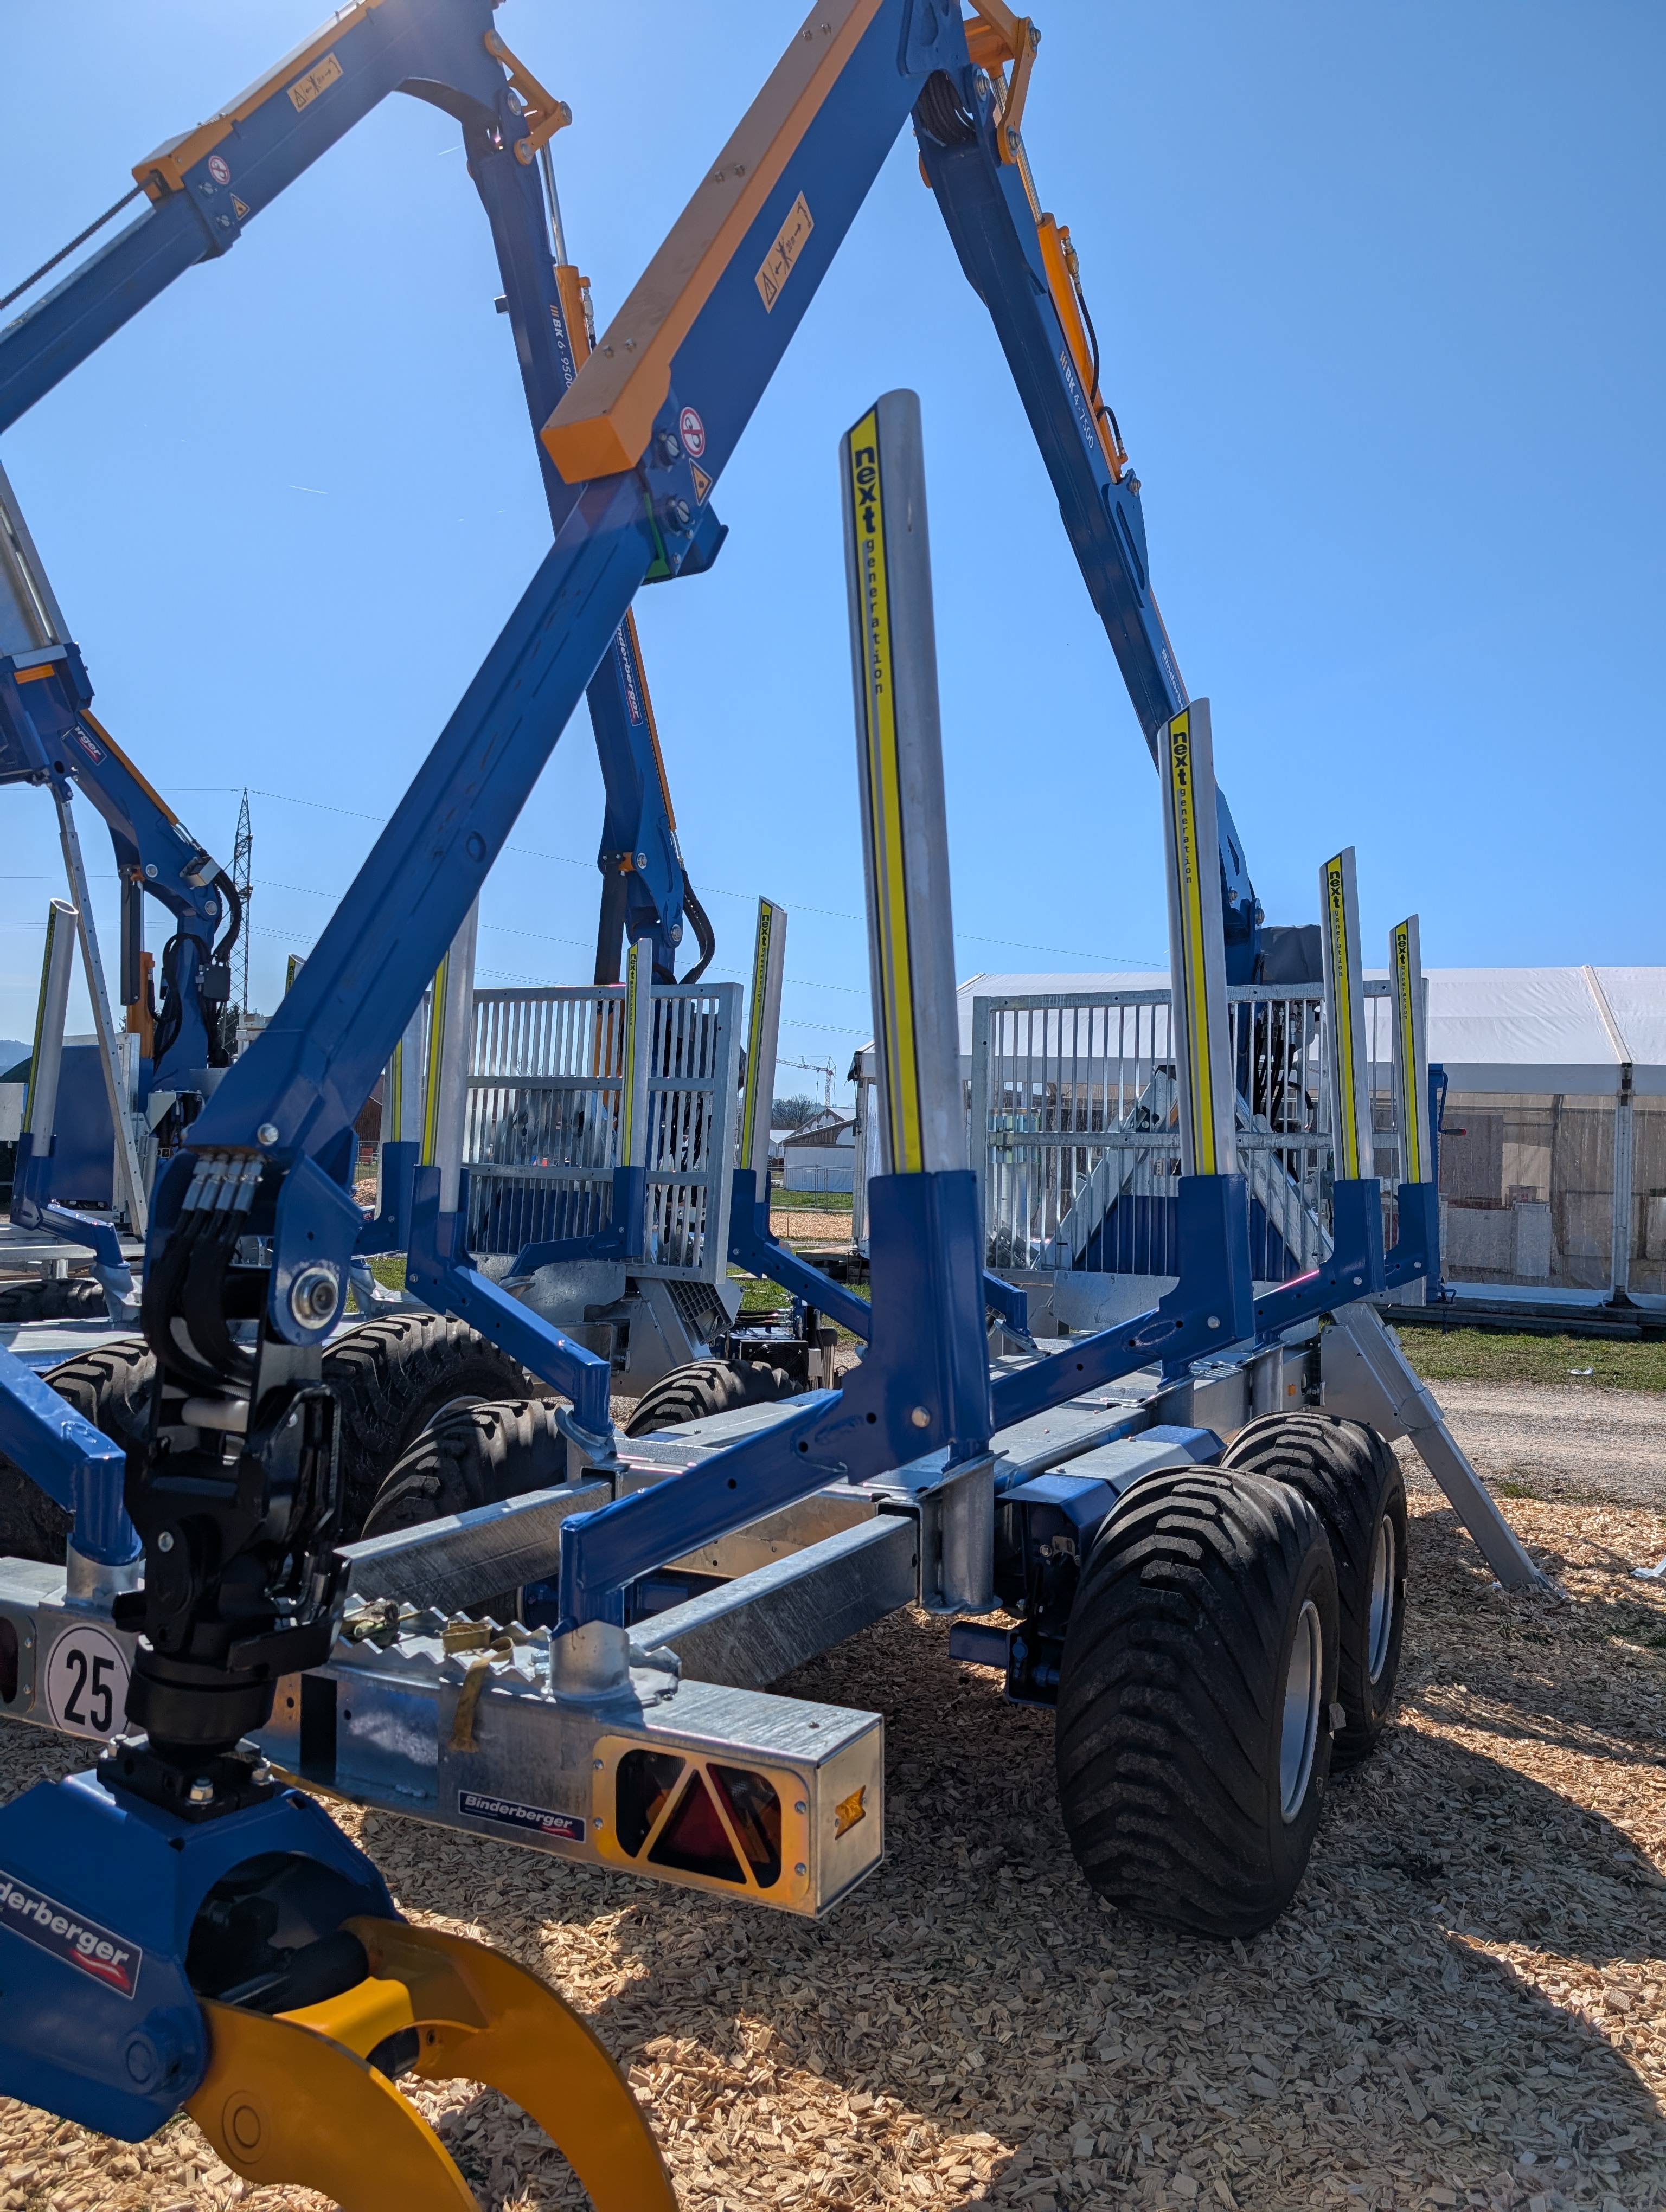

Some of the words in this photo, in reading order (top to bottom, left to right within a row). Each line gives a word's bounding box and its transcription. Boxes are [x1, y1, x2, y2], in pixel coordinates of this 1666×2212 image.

[553, 318, 564, 339] BK
[558, 340, 566, 349] 6
[1065, 366, 1075, 395] BK
[855, 446, 877, 533] next
[867, 539, 883, 695] generation
[1173, 732, 1189, 786] next
[1180, 789, 1192, 884] generation
[761, 914, 770, 946] next
[1329, 871, 1341, 909] next
[1335, 910, 1343, 977] generation
[1398, 934, 1406, 964] next
[757, 947, 765, 1003] generation
[64, 1649, 114, 1732] 25
[464, 1796, 573, 1829] Binderberger
